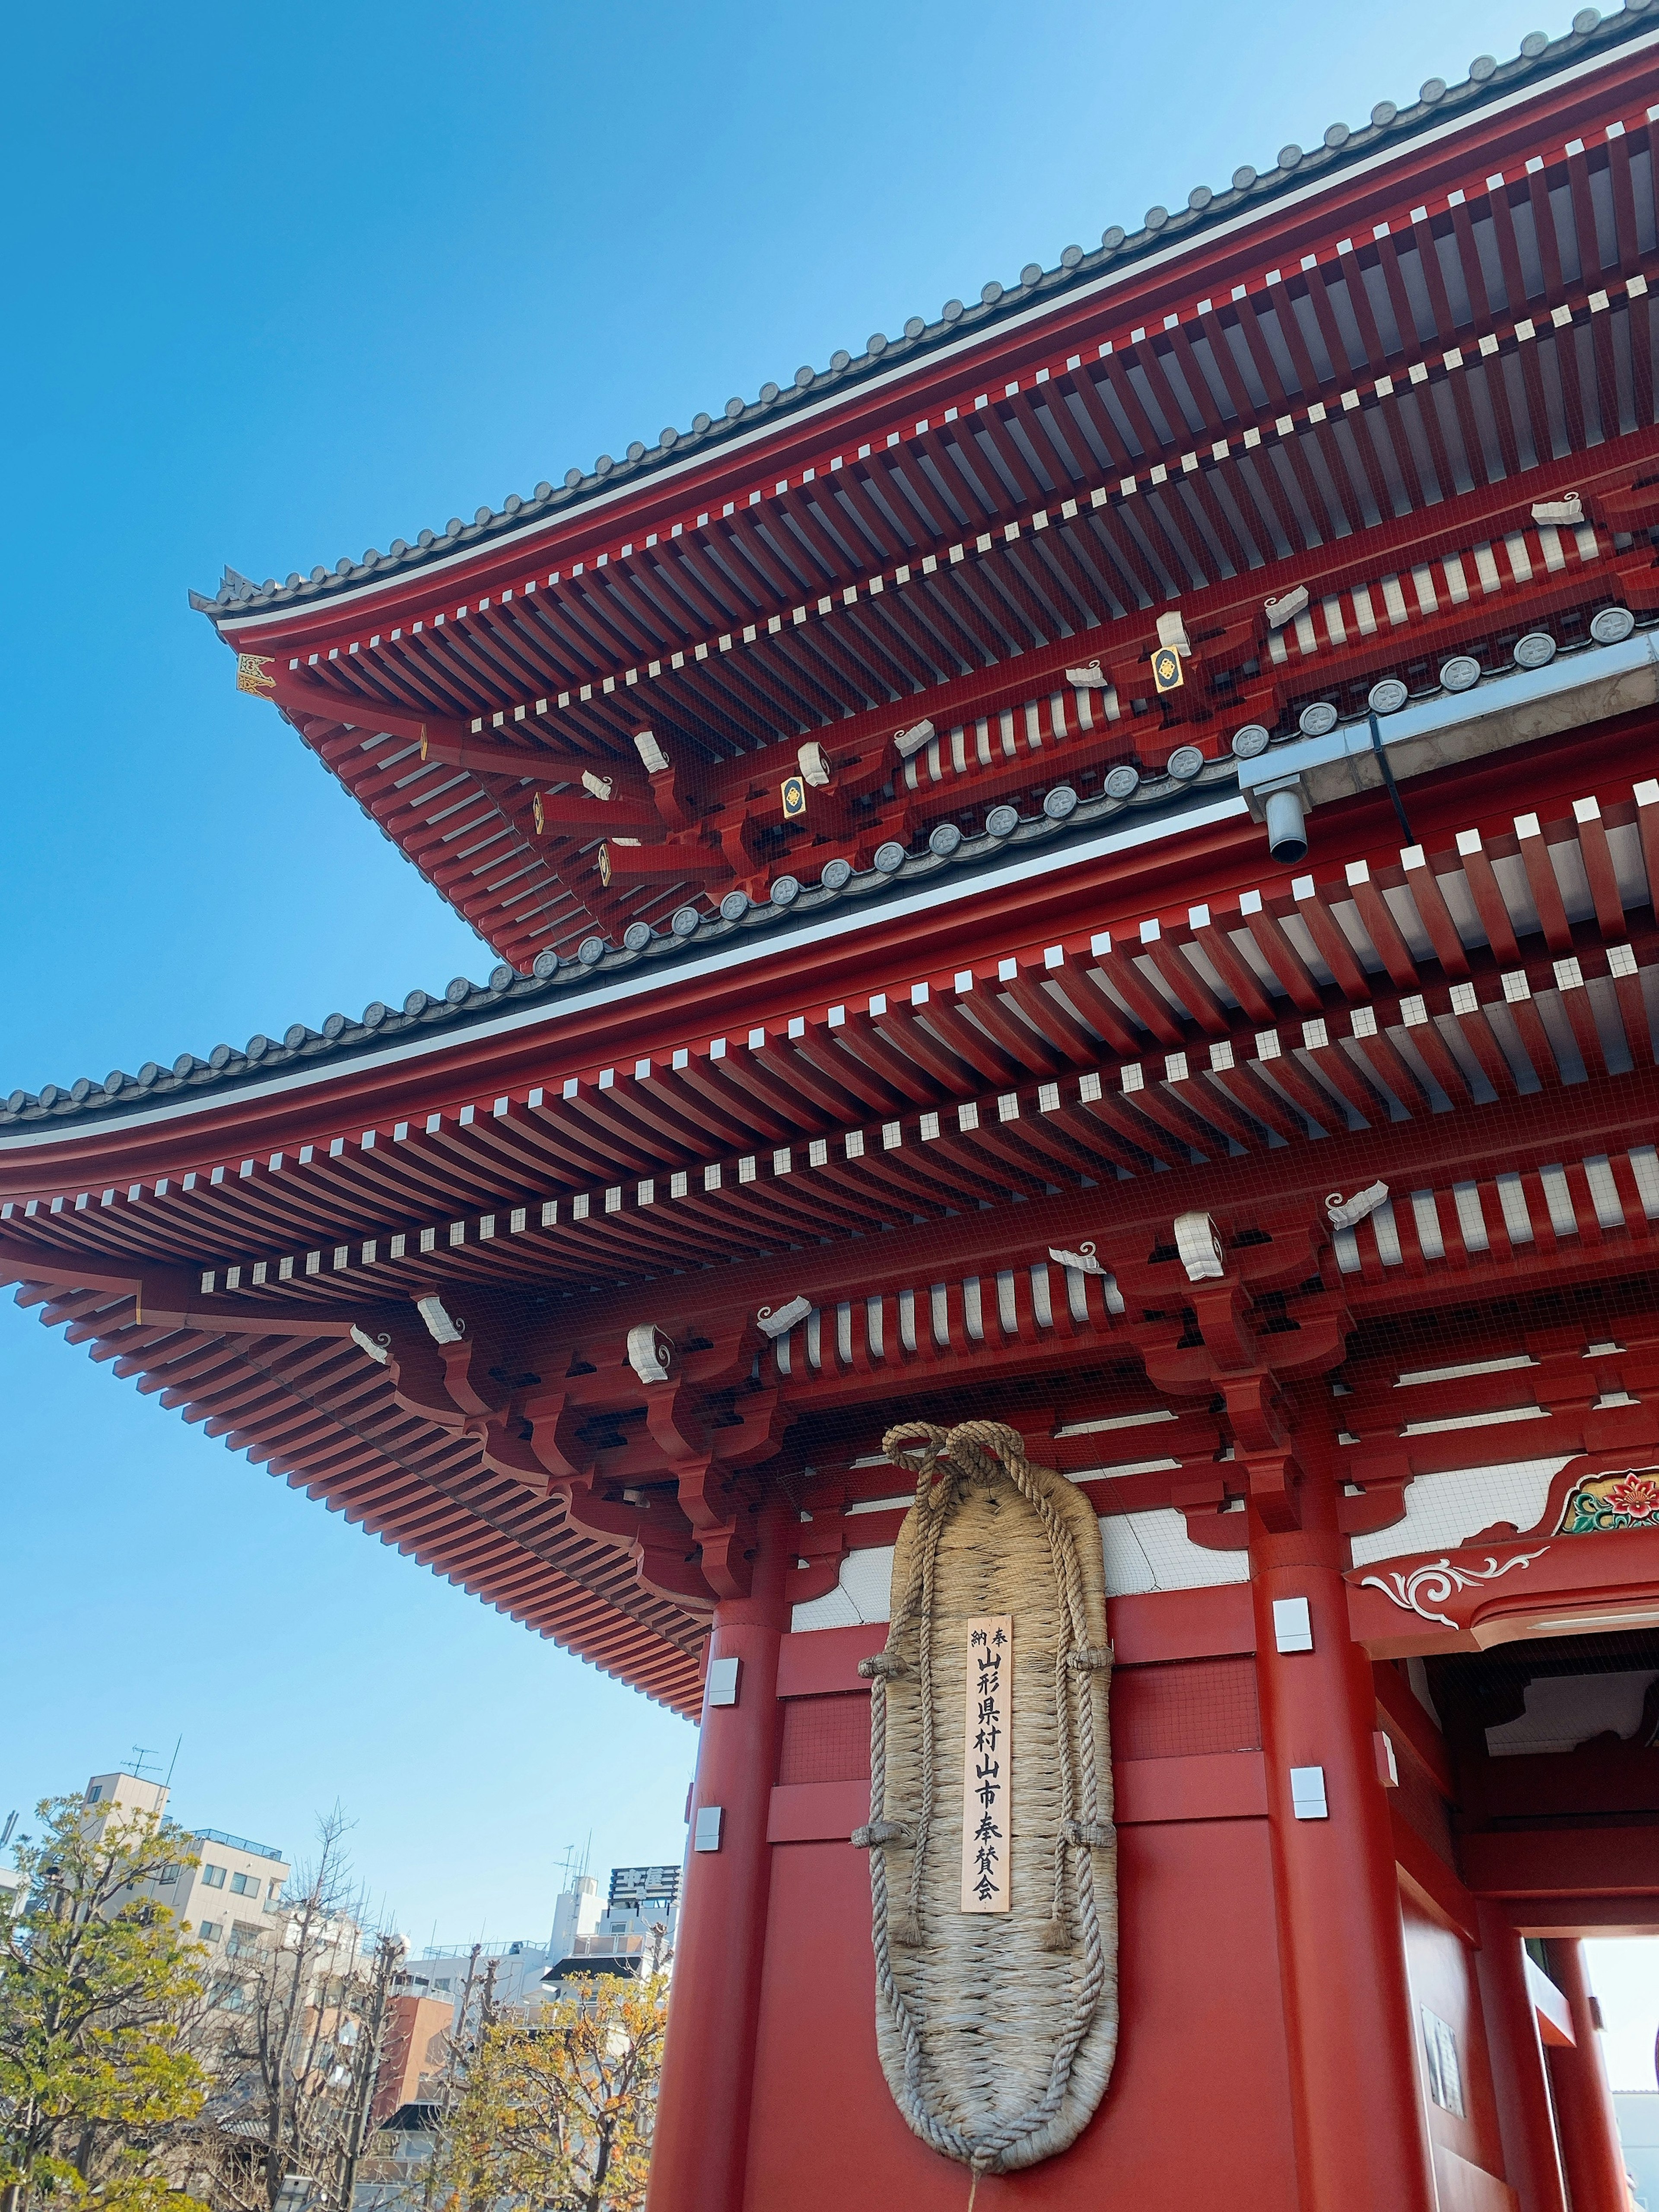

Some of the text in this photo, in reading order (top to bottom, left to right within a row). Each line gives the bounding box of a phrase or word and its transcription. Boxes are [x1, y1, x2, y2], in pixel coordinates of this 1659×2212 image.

[973, 1646, 1003, 1901] 山形県村山市奉賛会
